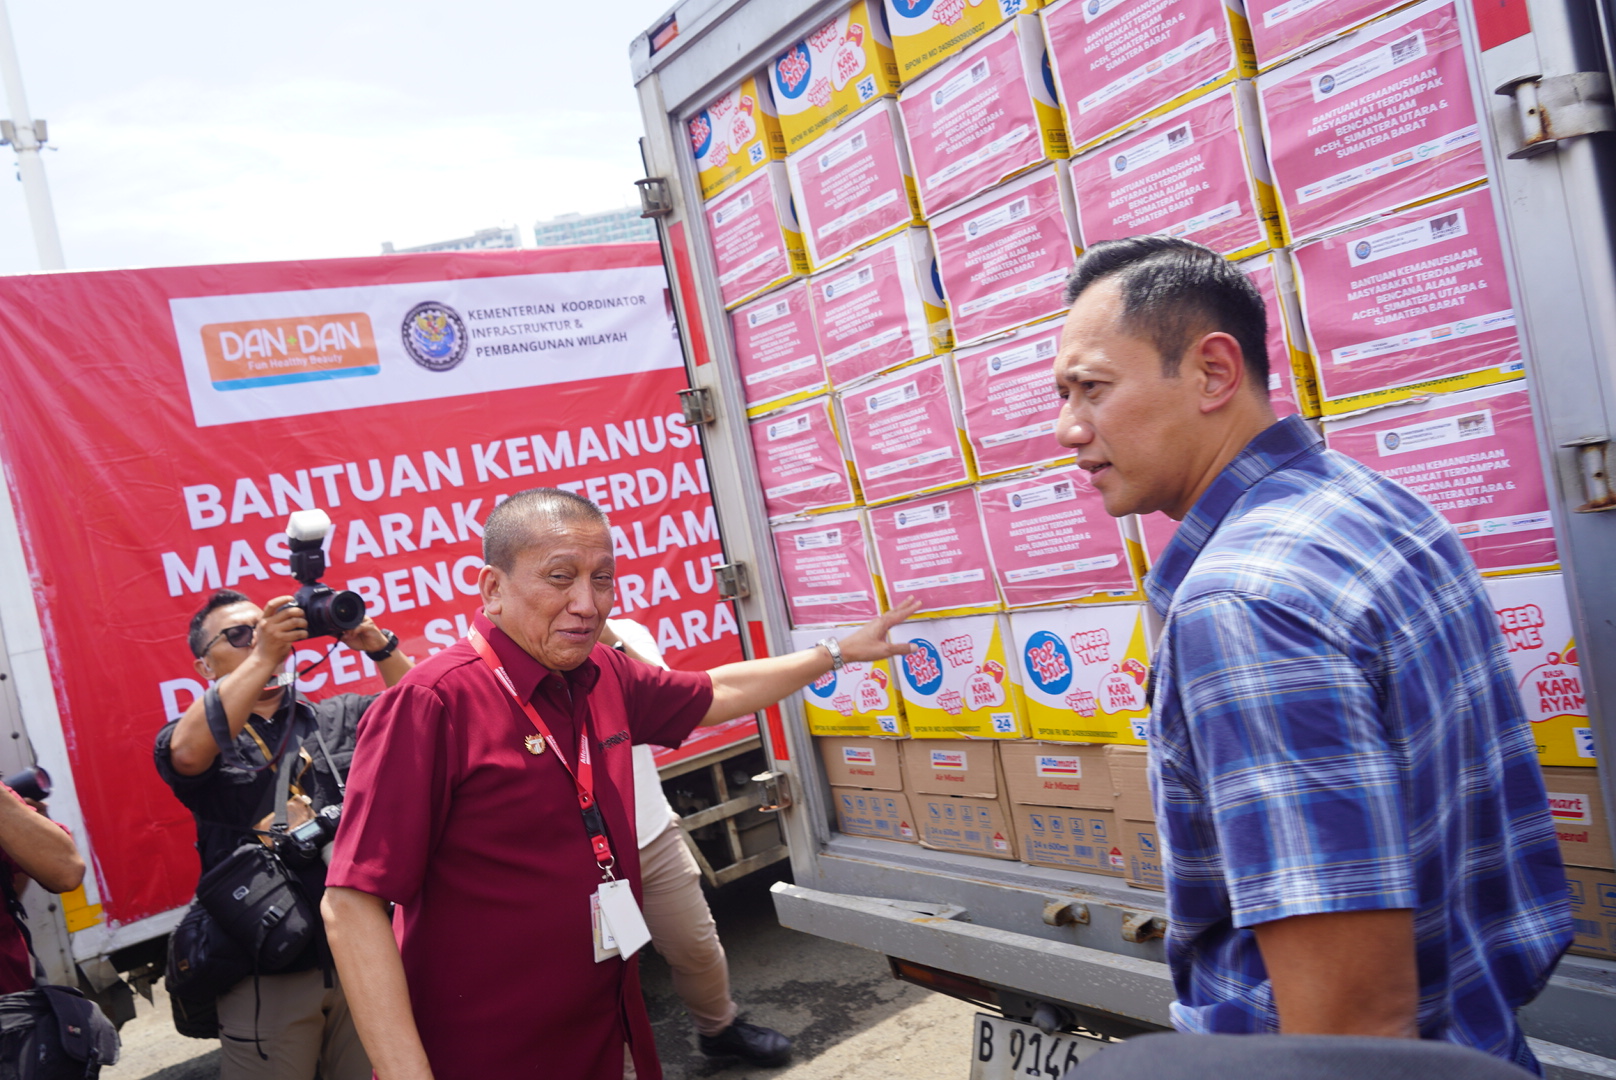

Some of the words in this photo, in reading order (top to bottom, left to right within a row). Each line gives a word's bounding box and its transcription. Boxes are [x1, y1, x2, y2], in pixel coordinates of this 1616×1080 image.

[1084, 21, 1132, 54] MASYARAKAT
[1133, 0, 1180, 25] TERDAMPA
[1086, 18, 1120, 43] BANTUAN
[1104, 28, 1140, 52] BENCANA
[1140, 14, 1162, 31] ALAM
[1110, 32, 1149, 58] SUMATERA
[1150, 17, 1178, 35] UTARA
[1105, 45, 1144, 71] SUMATERA
[1144, 30, 1171, 49] BARAT
[860, 82, 874, 97] 24
[1312, 99, 1358, 125] BANTUAN
[1360, 68, 1438, 105] KEMANUSIAAN
[1307, 104, 1374, 137] MASYARAKAT
[1376, 77, 1444, 109] TERDAMPAK
[1336, 112, 1385, 136] BENCANA
[1386, 99, 1417, 117] ALAM
[1344, 118, 1399, 144] SUMATERA
[1399, 104, 1438, 123] UTARA
[1439, 99, 1449, 109] &
[1336, 133, 1390, 158] SUMATERA
[1391, 118, 1427, 138] BARAT
[1108, 182, 1158, 209] MASYARAKAT
[1159, 162, 1205, 187] TERDAMPAK
[1111, 179, 1145, 198] BANTUAN
[1145, 154, 1201, 184] KEMANUSIAAN
[1128, 190, 1166, 209] BENCANA
[1166, 180, 1187, 194] ALAM
[1134, 196, 1175, 217] SUMATERA
[1175, 184, 1202, 199] UTARA
[1128, 208, 1169, 228] SUMATERA
[1168, 196, 1194, 212] BARAT
[1347, 276, 1414, 301] MASYARAKAT
[1415, 257, 1484, 282] TERDAMPAK
[1350, 270, 1396, 289] BANTUAN
[1397, 248, 1478, 276] KEMANUSIAAN
[1376, 285, 1424, 304] BENCANA
[1425, 276, 1457, 291] ALAM
[1383, 293, 1437, 312] SUMATERA
[1438, 282, 1477, 298] UTARA
[1478, 280, 1488, 288] &
[468, 304, 555, 320] KEMENTERIAN
[562, 295, 646, 313] KOORDINATOR
[1374, 306, 1428, 325] SUMATERA
[1428, 296, 1466, 309] BARAT
[472, 320, 573, 339] INFRASTRUKTUR
[574, 319, 583, 329] &
[476, 338, 574, 358] PEMBANGUNAN
[578, 332, 628, 346] WILAYAH
[248, 360, 269, 371] Fun
[270, 356, 307, 370] Healthy
[310, 354, 342, 365] Beauty
[182, 448, 464, 530] BANTUAN
[471, 412, 701, 483] KEMANUS
[1426, 449, 1505, 470] KEMANUSIAAN
[1442, 459, 1511, 477] TERDAMPAK
[1410, 480, 1452, 493] ENCANA
[1453, 475, 1484, 487] ALAM
[1465, 482, 1505, 495] UTARA
[1506, 481, 1516, 489] &
[1457, 495, 1494, 508] BARAT
[347, 555, 485, 617] BENC
[612, 506, 720, 560] ALAM
[658, 602, 738, 656] ARA
[906, 647, 927, 671] POP
[1028, 640, 1055, 669] POP
[861, 689, 877, 698] KARI
[972, 682, 991, 694] KARI
[974, 693, 996, 705] AYAM
[1108, 684, 1131, 696] KARI
[1536, 678, 1580, 697] KARI
[862, 698, 881, 708] AYAM
[1110, 695, 1137, 708] AYAM
[881, 721, 894, 730] 24
[996, 720, 1011, 729] 24
[846, 749, 871, 758] Alfamart
[933, 752, 962, 762] Alfamart
[1041, 758, 1077, 768] Alfamart
[944, 774, 965, 782] Mineral
[1044, 781, 1054, 790] Air
[1055, 782, 1080, 791] Mineral
[1548, 799, 1583, 810] mart
[979, 1020, 993, 1062] B
